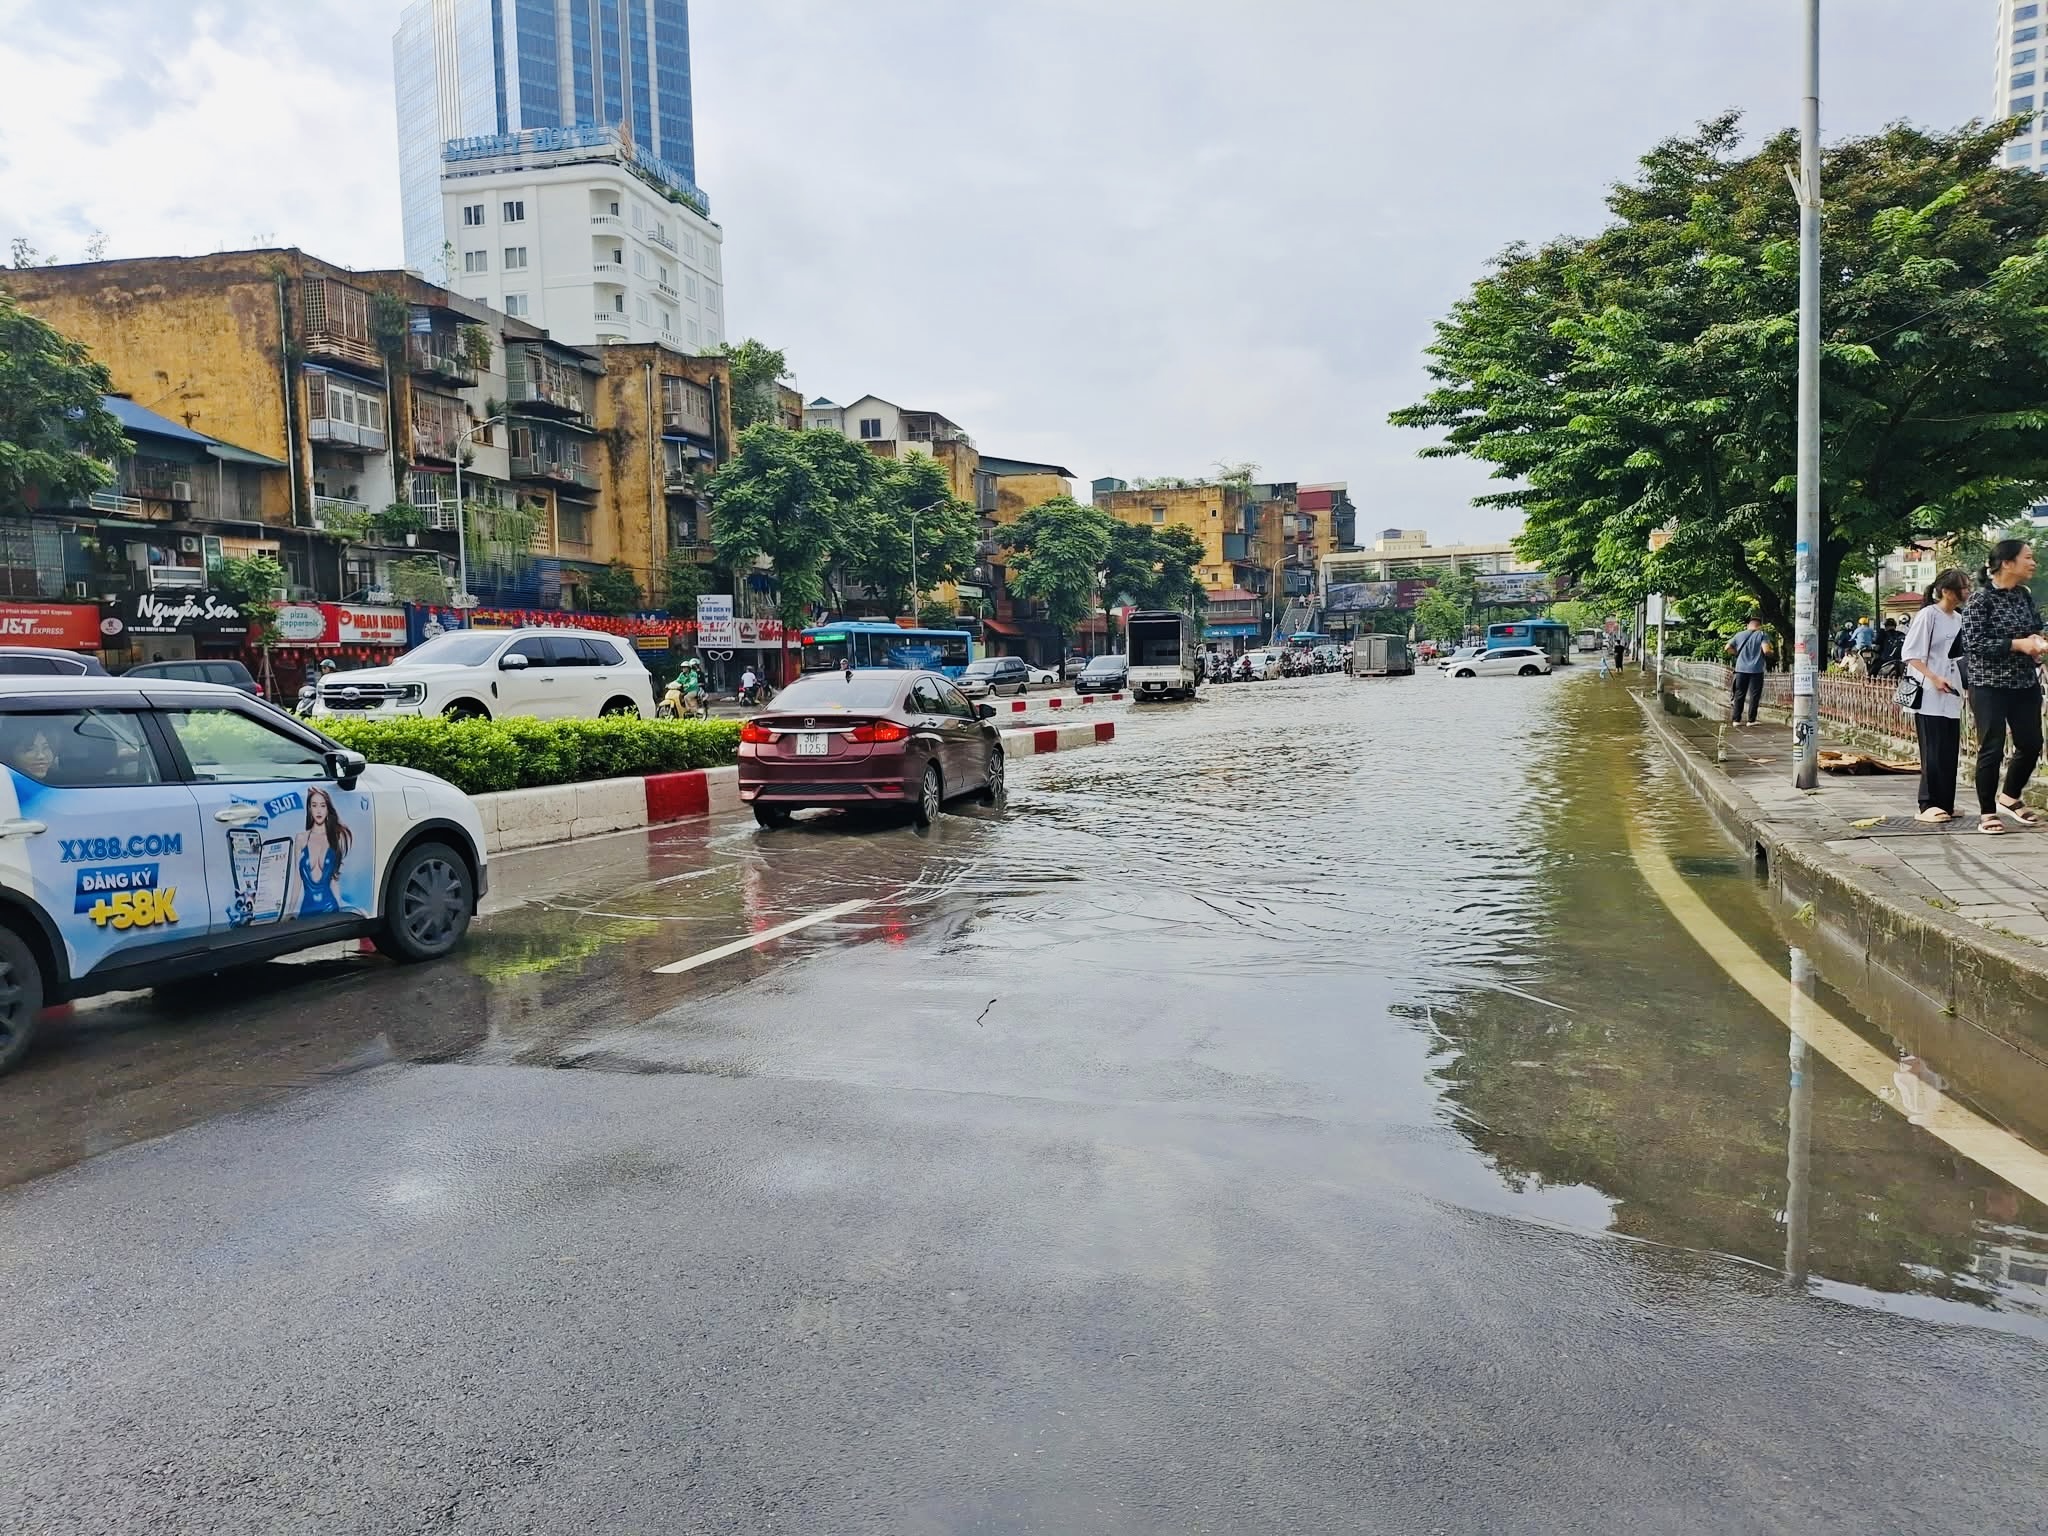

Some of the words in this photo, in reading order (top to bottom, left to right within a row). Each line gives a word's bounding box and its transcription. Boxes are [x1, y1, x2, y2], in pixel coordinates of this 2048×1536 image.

[137, 593, 204, 626] Nguyễn
[290, 610, 308, 619] pizza
[0, 618, 39, 635] J&T
[33, 627, 64, 635] EXPRESS
[805, 734, 820, 744] 30F
[270, 794, 297, 814] SLOT
[58, 833, 182, 863] XX88.COM
[82, 871, 128, 891] ĐĂNG
[132, 867, 151, 887] KÝ
[89, 886, 179, 930] +58K
